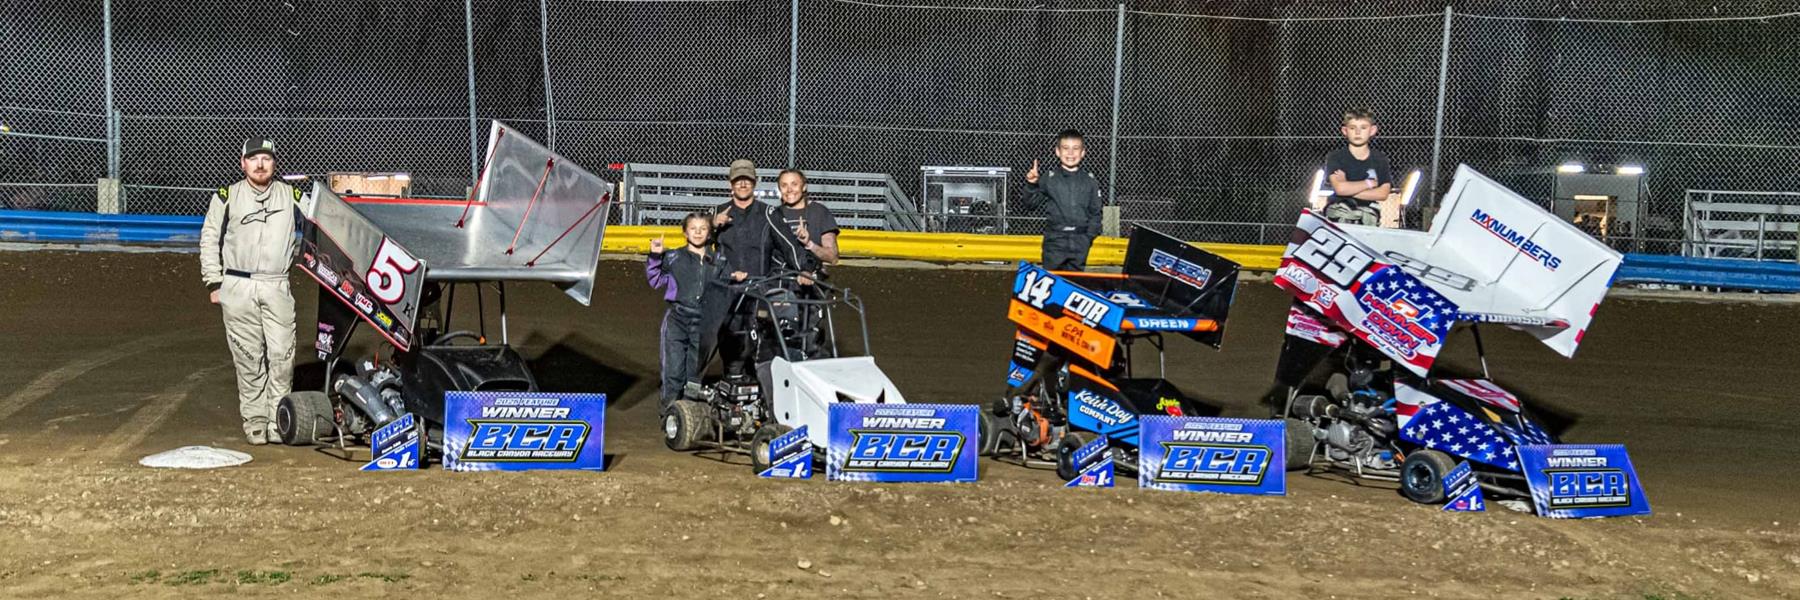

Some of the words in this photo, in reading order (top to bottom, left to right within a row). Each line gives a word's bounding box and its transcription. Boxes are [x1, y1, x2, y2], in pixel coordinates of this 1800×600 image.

[365, 234, 420, 305] 5
[1292, 225, 1375, 289] 29
[1017, 269, 1056, 309] 14
[402, 302, 415, 319] K
[1363, 293, 1438, 346] HAMMER
[1367, 311, 1421, 350] DOWN
[482, 406, 571, 419] WINNER
[1074, 389, 1109, 411] Keith
[1105, 402, 1135, 424] Day
[1079, 404, 1117, 426] COMPANY
[469, 423, 586, 451] BCR
[862, 417, 946, 429] WINNER
[1172, 430, 1254, 443] WINNER
[497, 450, 530, 458] CANYON
[851, 432, 962, 461] BCR
[1162, 445, 1269, 475] BCR
[1546, 457, 1608, 467] WINNER
[1551, 471, 1627, 497] BCR
